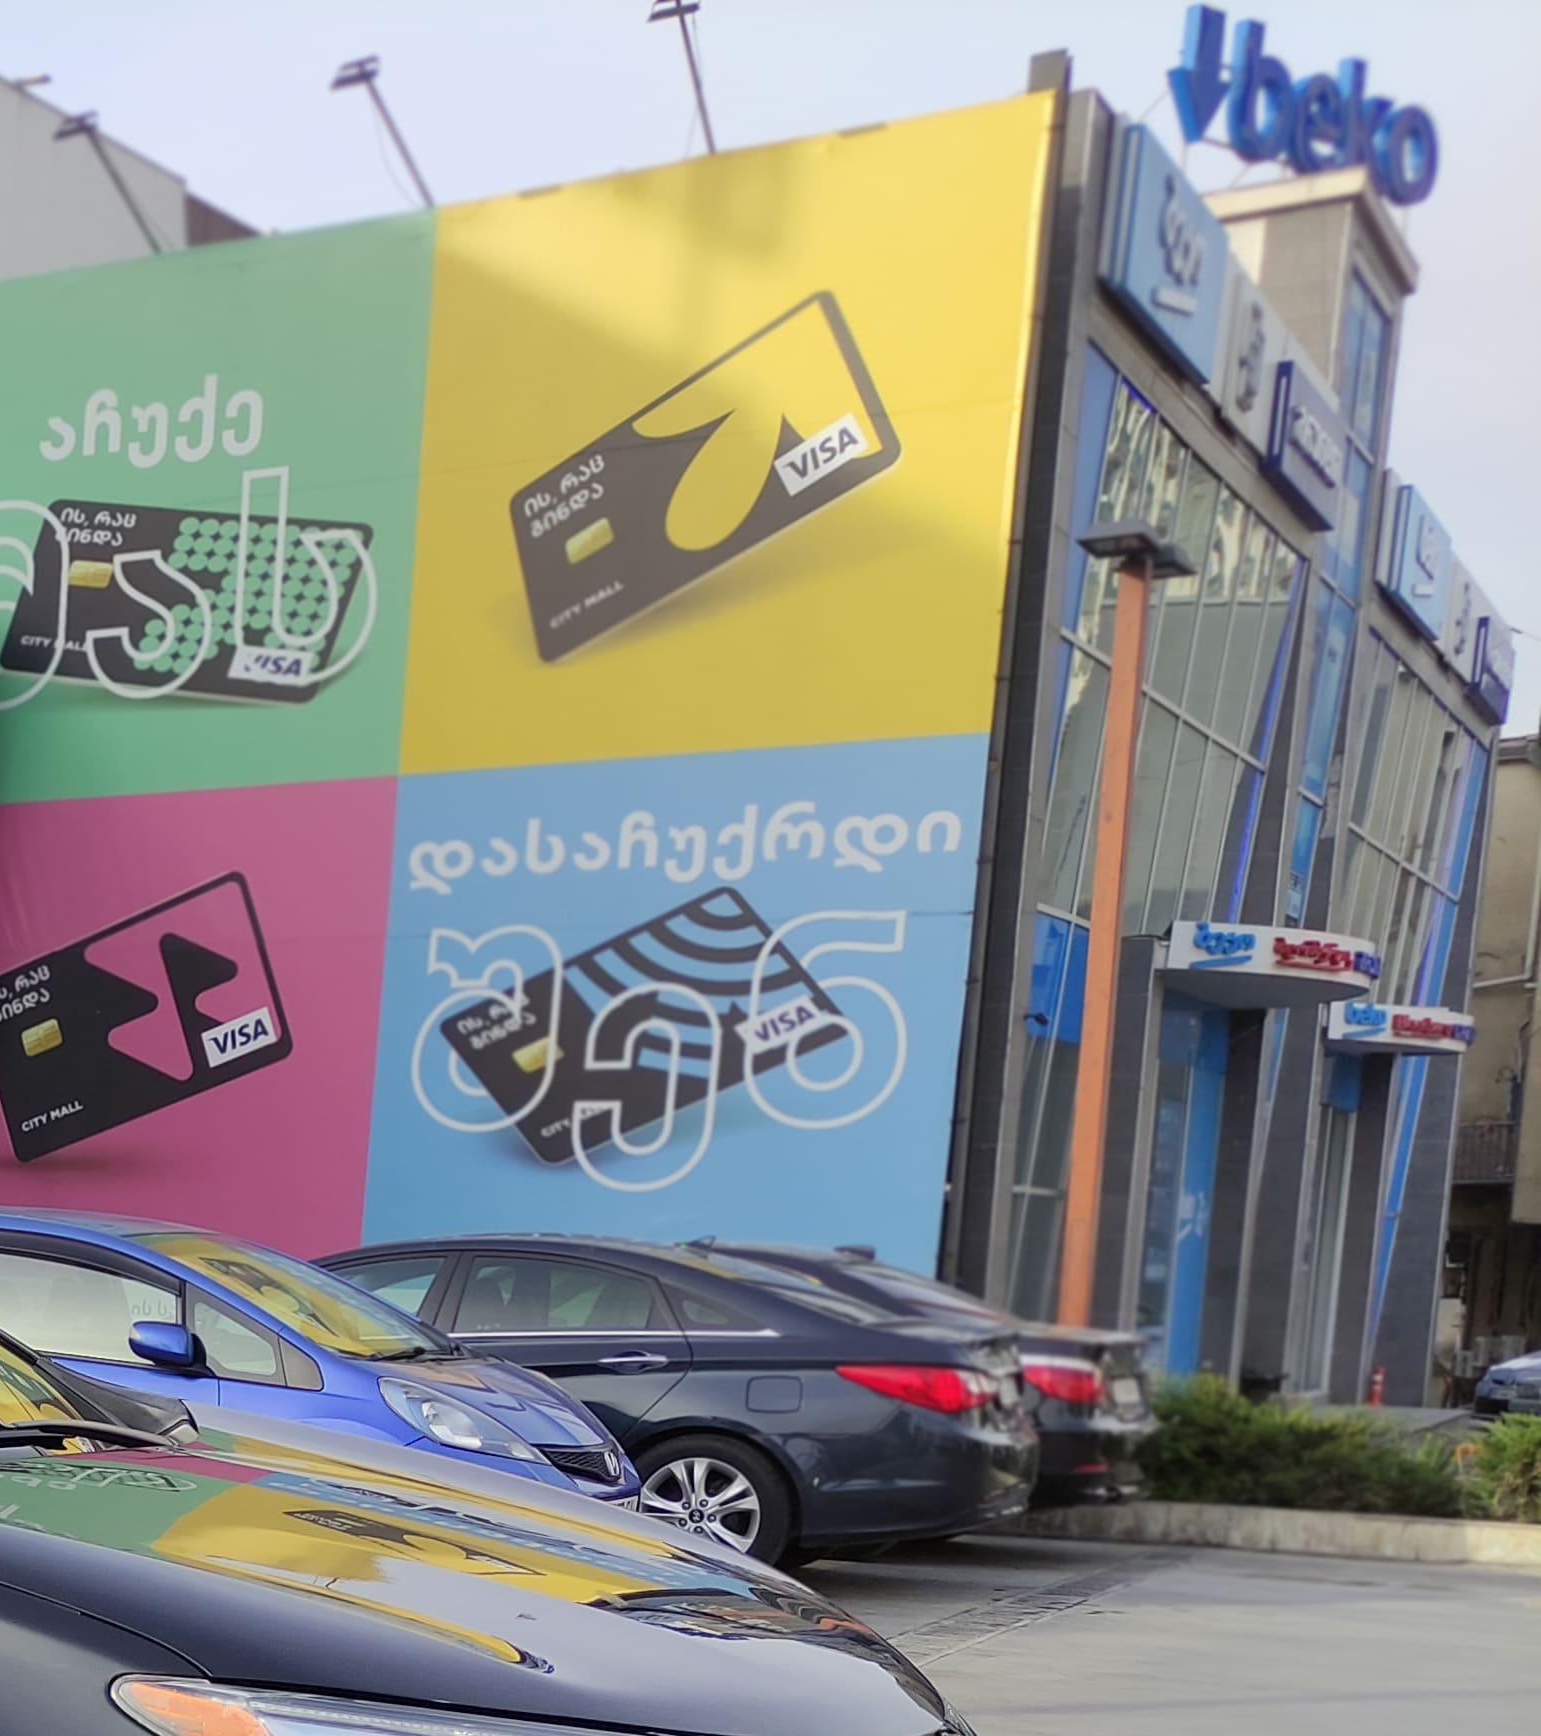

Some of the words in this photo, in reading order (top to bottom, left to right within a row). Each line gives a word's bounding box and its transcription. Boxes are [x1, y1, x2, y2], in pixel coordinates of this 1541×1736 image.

[1227, 18, 1440, 206] beko
[39, 374, 263, 468] აჩუქე
[781, 426, 860, 480] VISA
[560, 454, 606, 495] რაც
[94, 510, 138, 529] რაც
[529, 482, 605, 539] გინდა
[548, 603, 581, 629] CITY
[584, 580, 625, 609] MALL
[20, 635, 52, 649] CITY
[408, 801, 963, 895] დასაჩუქრდი
[14, 964, 51, 994] რაც
[207, 1018, 269, 1055] VISA
[755, 1005, 815, 1042] VISA
[21, 1114, 48, 1132] CITY
[50, 1100, 84, 1122] MALL
